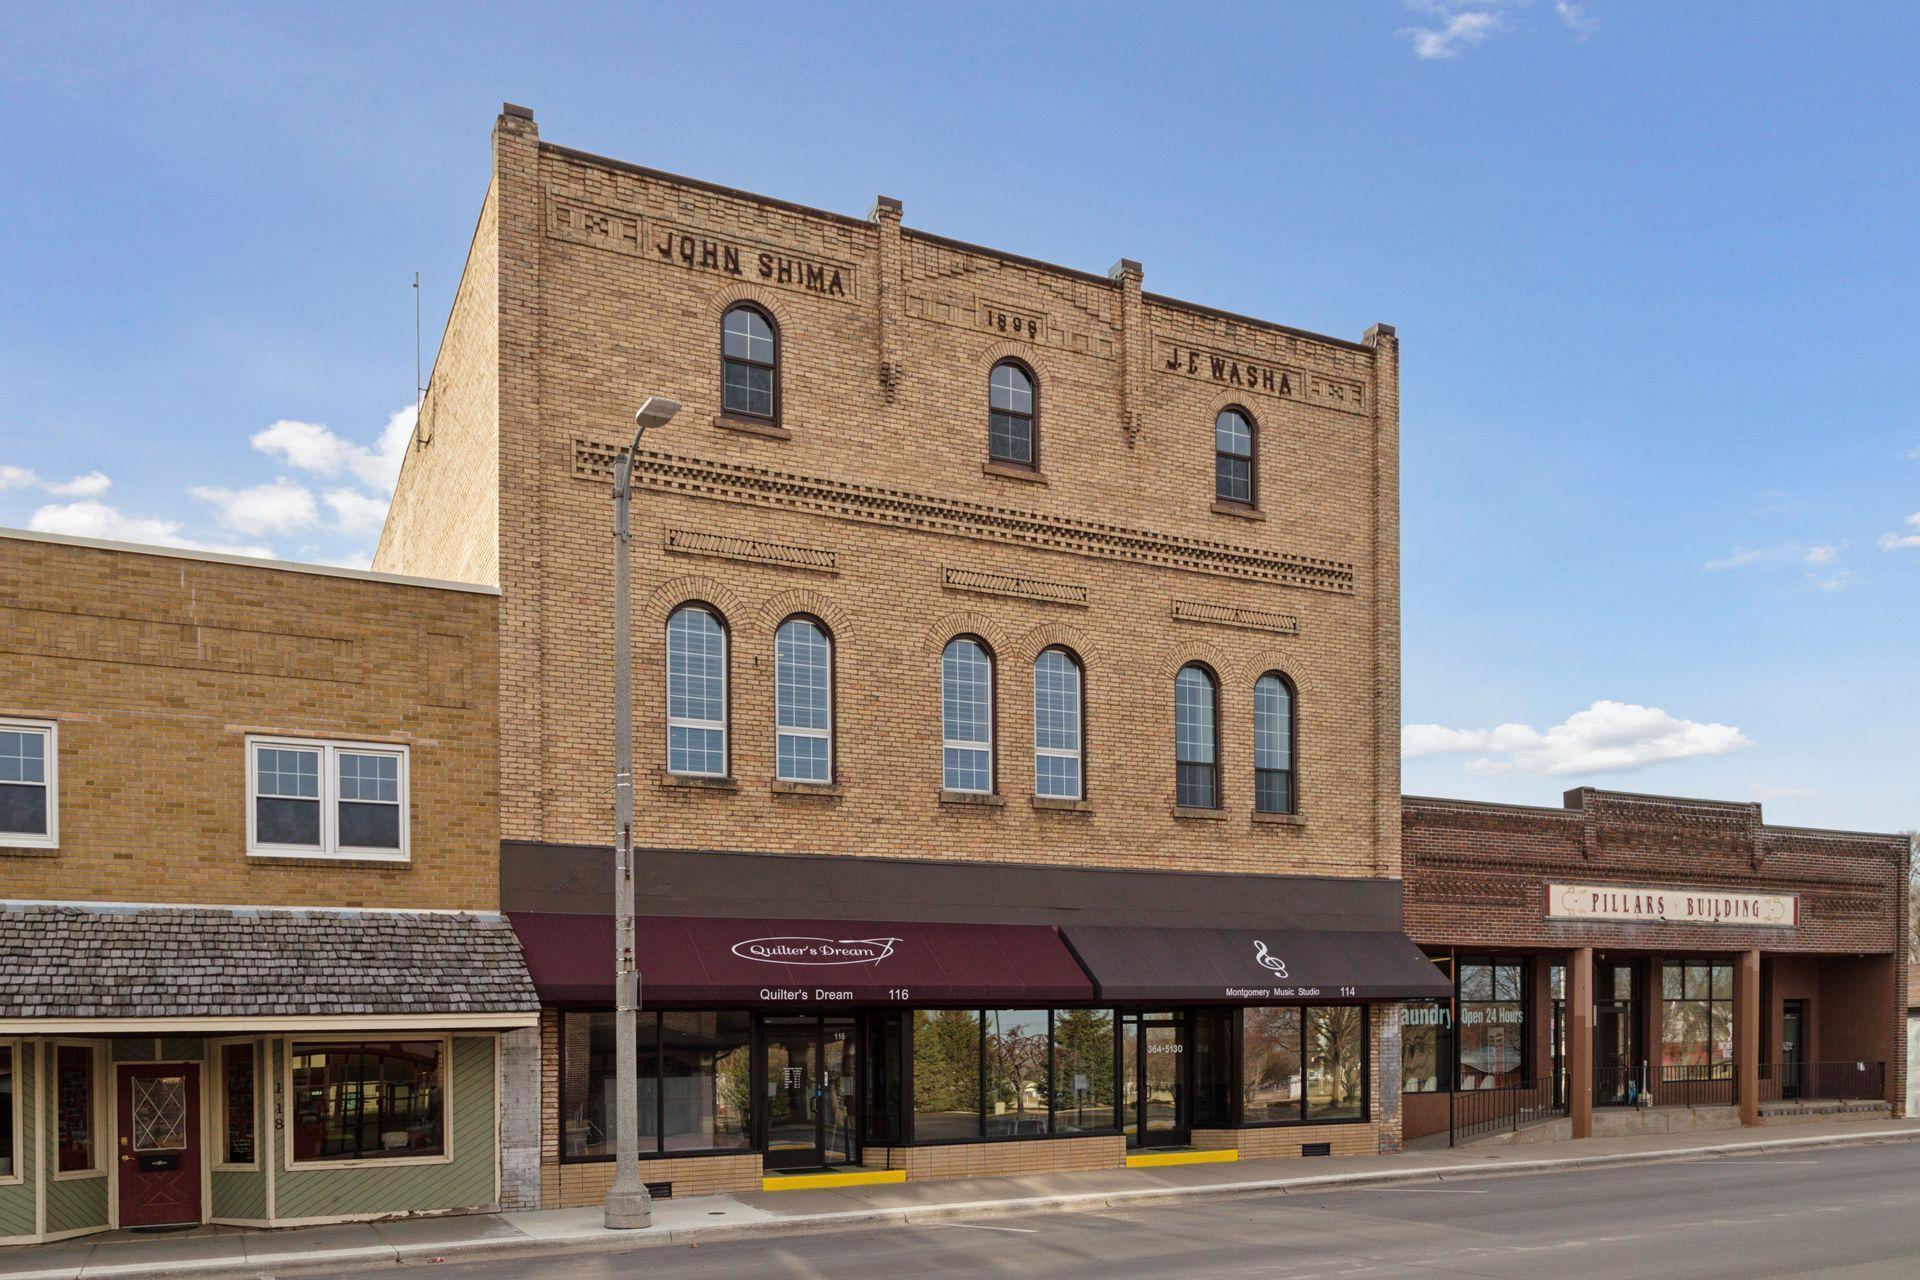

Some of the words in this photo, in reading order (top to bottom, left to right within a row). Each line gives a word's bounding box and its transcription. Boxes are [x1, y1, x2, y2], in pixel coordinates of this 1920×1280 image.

[656, 232, 743, 275] JOHN
[758, 253, 846, 297] SHIMA
[1210, 355, 1292, 396] WASHA
[1591, 893, 1665, 915] PILLARS
[1686, 897, 1760, 918] BUILDING
[750, 944, 817, 956] Quilter's
[819, 945, 875, 957] Dream
[760, 988, 809, 1001] Quilter's
[815, 988, 854, 1001] Dream
[888, 988, 909, 1001] 116
[1225, 987, 1270, 998] Montgomery
[1273, 987, 1295, 997] Music
[1298, 987, 1320, 997] Studio
[1340, 986, 1356, 997] 114
[1401, 1004, 1452, 1030] aundry
[1461, 1007, 1484, 1028] Open
[1485, 1007, 1497, 1024] 24
[1499, 1007, 1524, 1024] Hours
